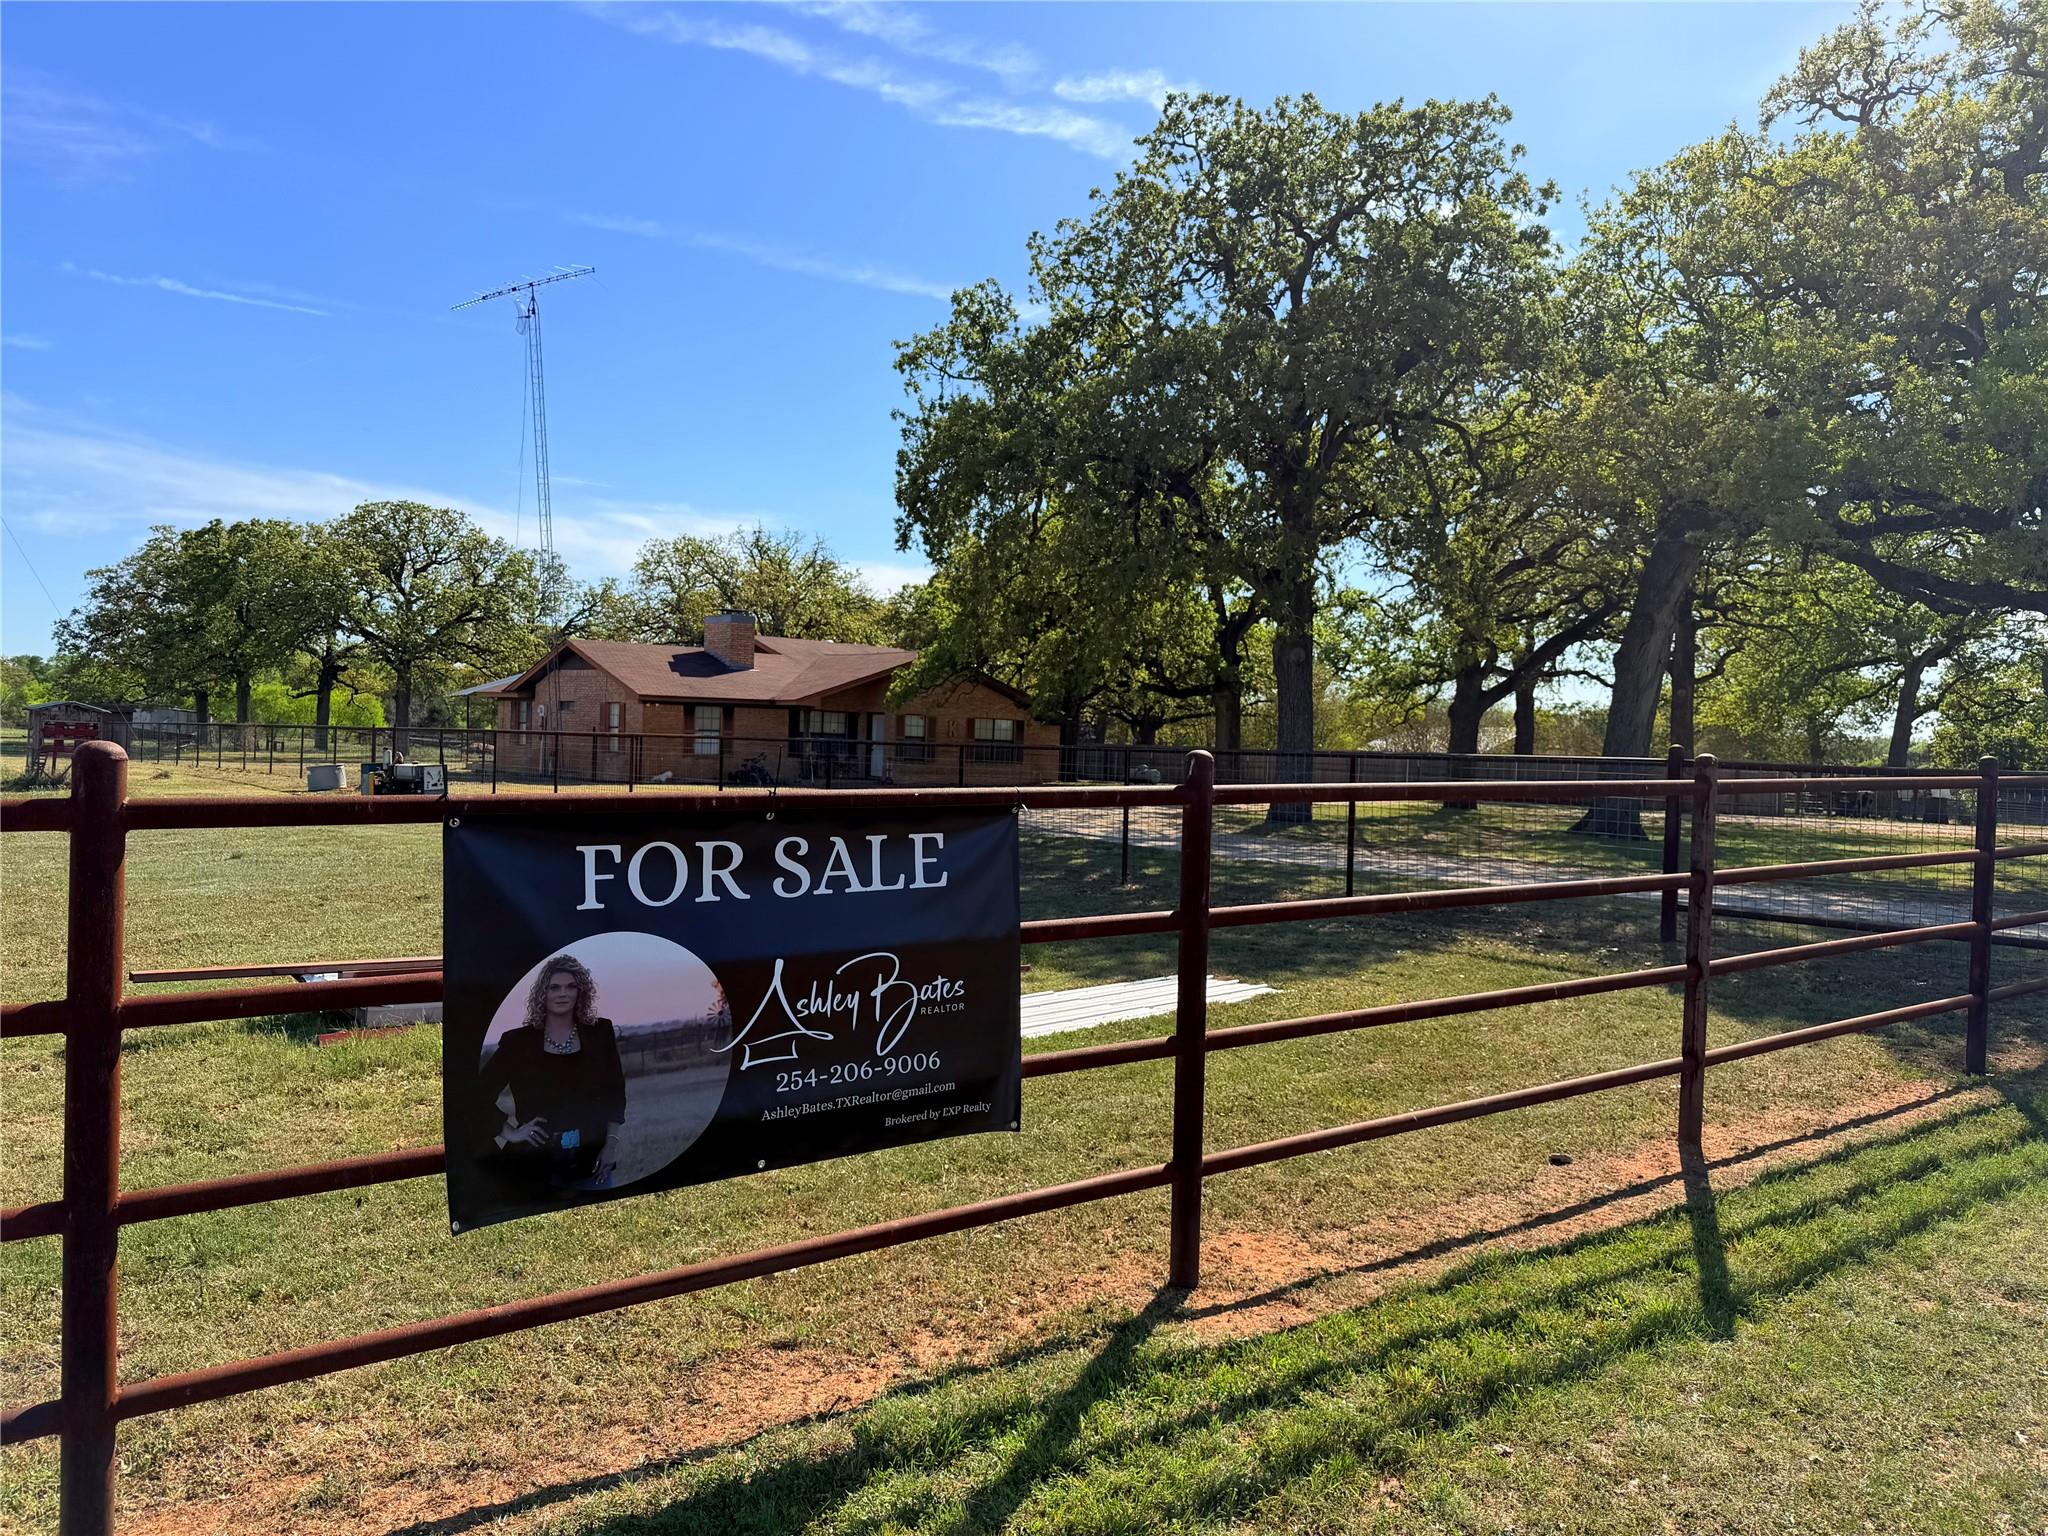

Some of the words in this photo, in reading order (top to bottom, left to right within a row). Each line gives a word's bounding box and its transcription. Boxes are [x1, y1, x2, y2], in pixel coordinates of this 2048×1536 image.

[575, 841, 751, 910] FOR
[773, 832, 948, 898] SALE
[711, 958, 861, 1054] Ashley
[836, 952, 965, 1057] Bates
[920, 1002, 965, 1015] REALTOR
[776, 1051, 941, 1093] 254-206-9006
[761, 1081, 956, 1122] AshleyBates.TXRealtor@gmail.com
[885, 1110, 928, 1127] Brokered
[928, 1109, 941, 1120] by
[942, 1105, 961, 1117] EXP
[963, 1101, 992, 1114] Realty
